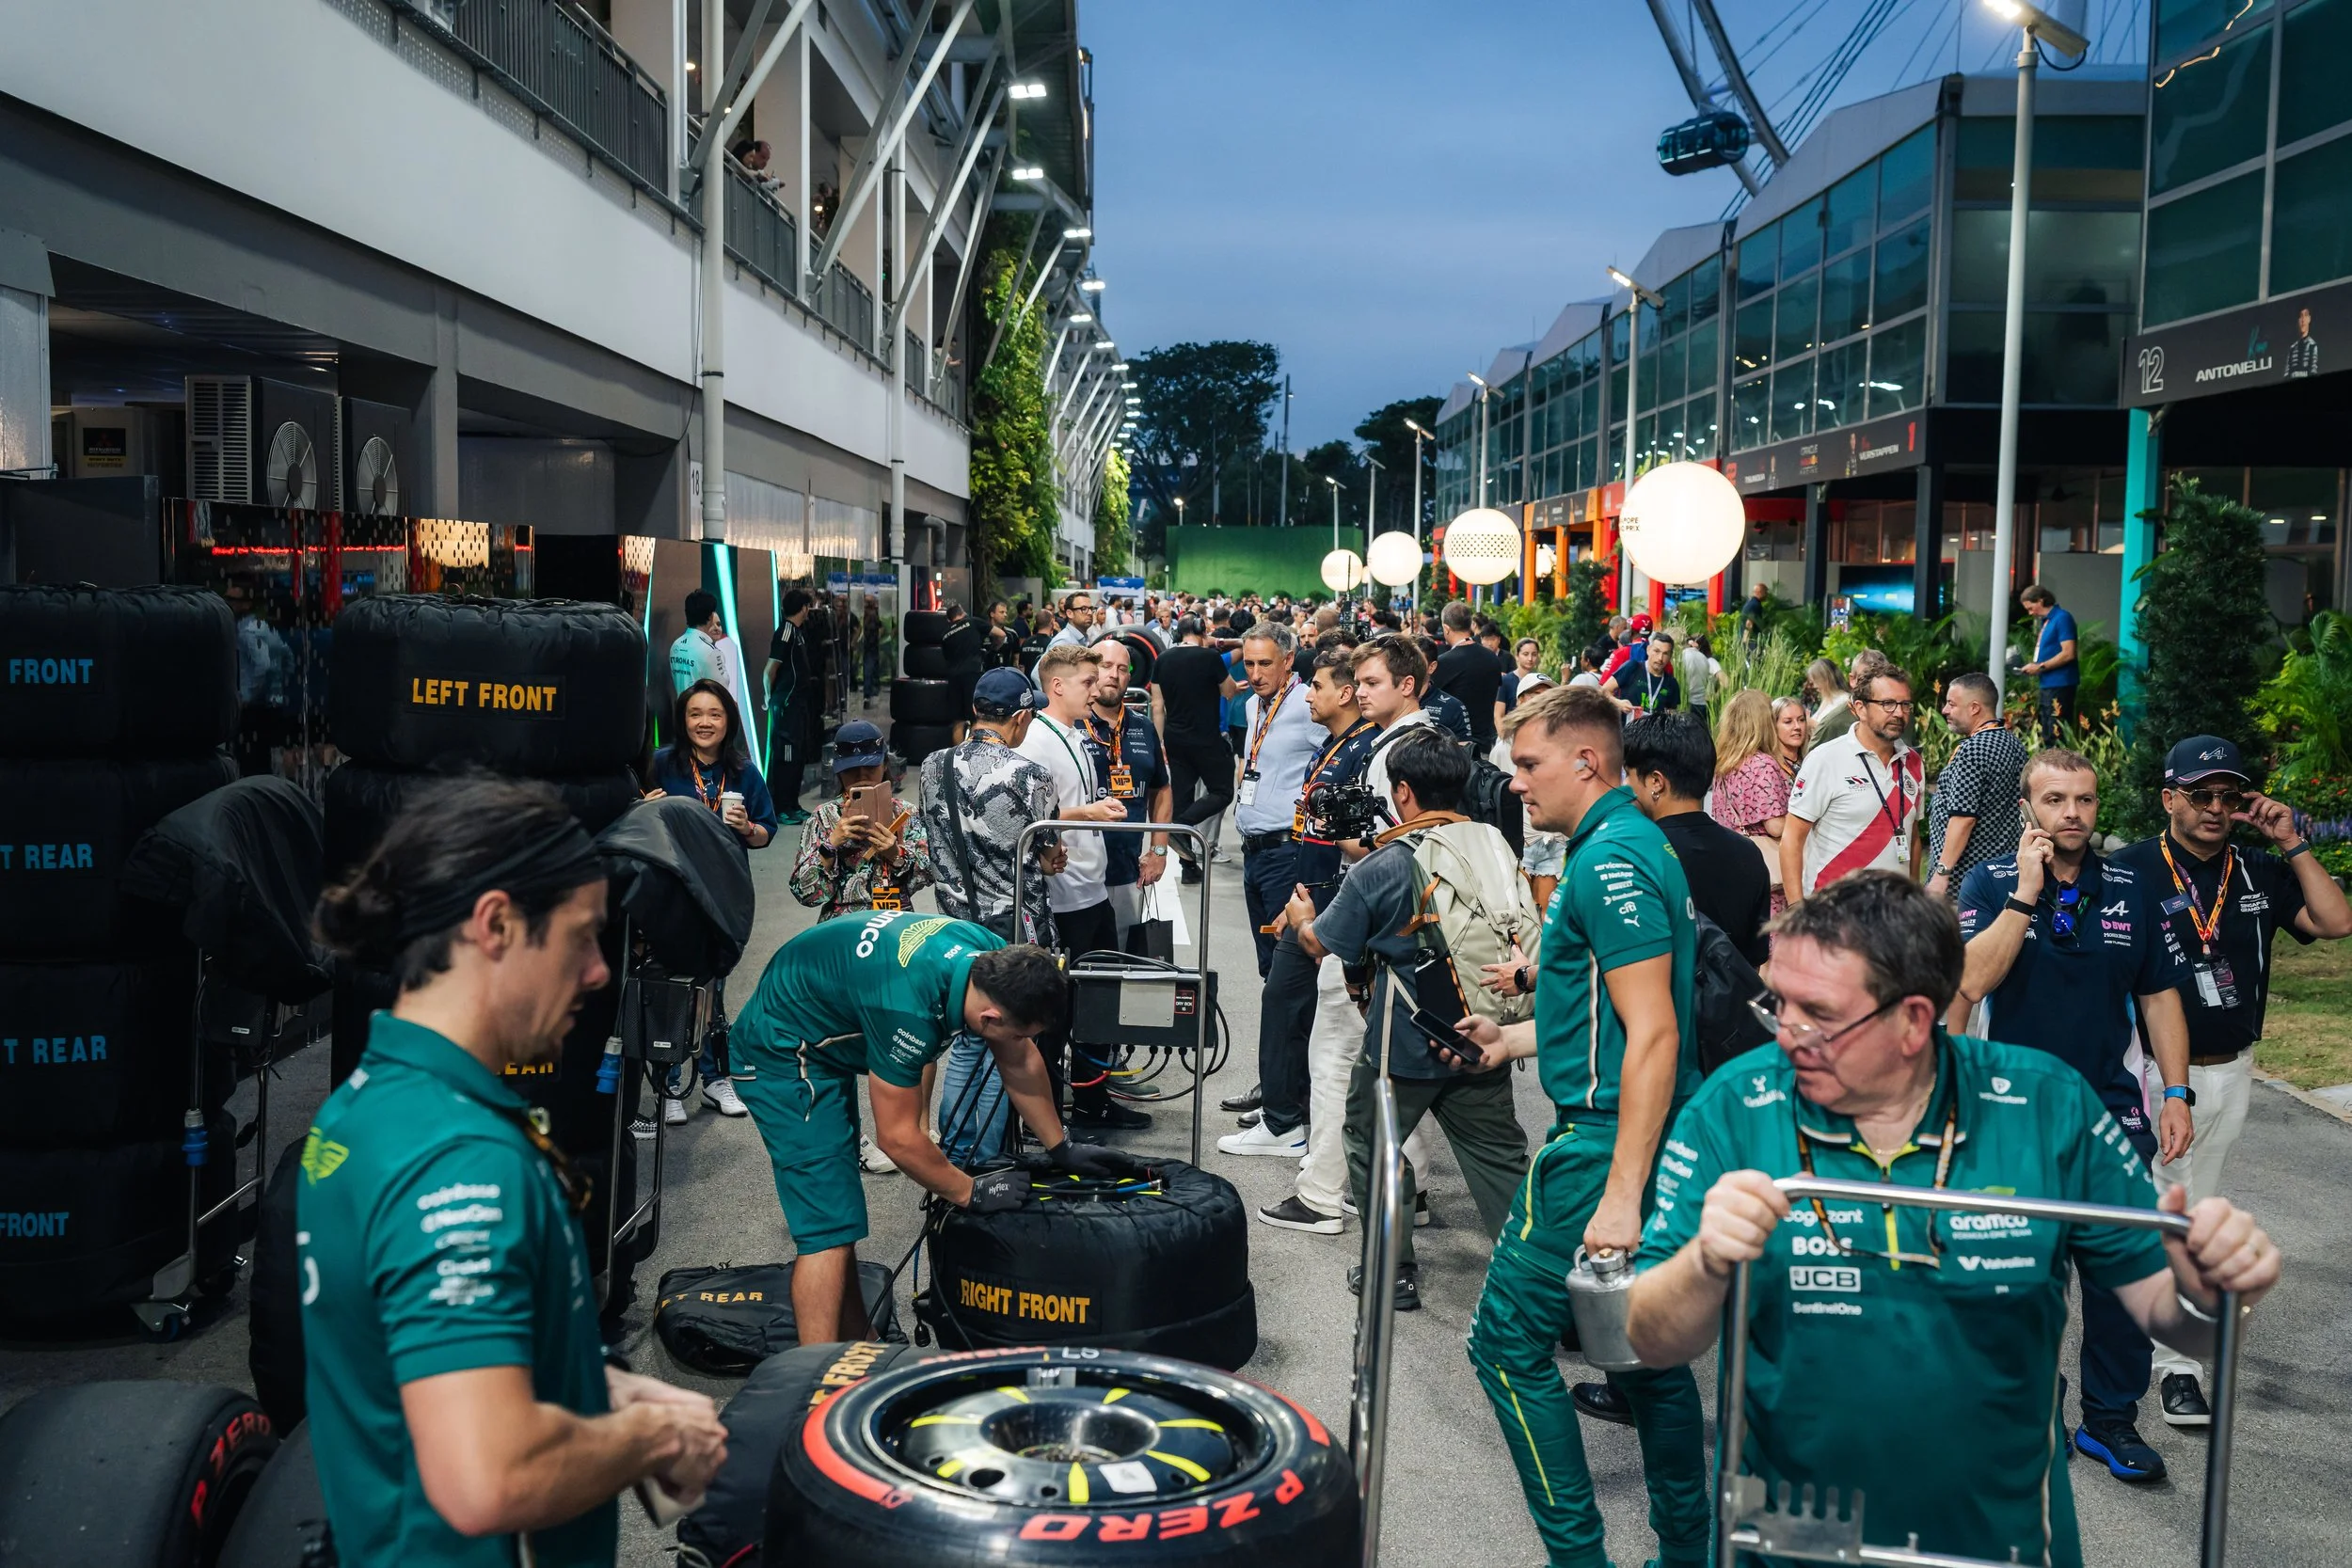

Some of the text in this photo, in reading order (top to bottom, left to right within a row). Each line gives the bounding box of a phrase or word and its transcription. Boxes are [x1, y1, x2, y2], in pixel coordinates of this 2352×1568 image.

[2138, 346, 2164, 394] 12
[2195, 356, 2272, 382] ANTONELLI
[1908, 421, 1915, 451] 1
[691, 469, 700, 496] 18
[9, 657, 93, 684] FRONT
[412, 677, 557, 711] LEFT FRONT
[1113, 777, 1131, 786] VIP
[1133, 781, 1146, 798] ull
[24, 843, 93, 869] REAR
[2109, 867, 2134, 876] Microsoft
[1619, 901, 1637, 914] citi
[2112, 921, 2131, 931] BWT
[897, 1038, 922, 1055] NexGen
[898, 1028, 926, 1047] coinbase
[33, 1036, 106, 1064] REAR
[497, 1061, 554, 1075] EAR
[989, 1182, 1009, 1195] HyFlex
[0, 1212, 70, 1237] FRONT
[1784, 1208, 1864, 1227] cogzant
[1949, 1213, 2028, 1231] aramco
[1792, 1235, 1852, 1257] BOSS
[1794, 1270, 1856, 1288] JCB
[700, 1291, 763, 1303] REAR
[961, 1278, 1090, 1323] RIGHT FRONT
[1792, 1301, 1862, 1315] SentinelOne
[821, 1340, 890, 1385] FRONT
[191, 1412, 271, 1529] P ZERO
[1019, 1468, 1305, 1543] P ZERO
